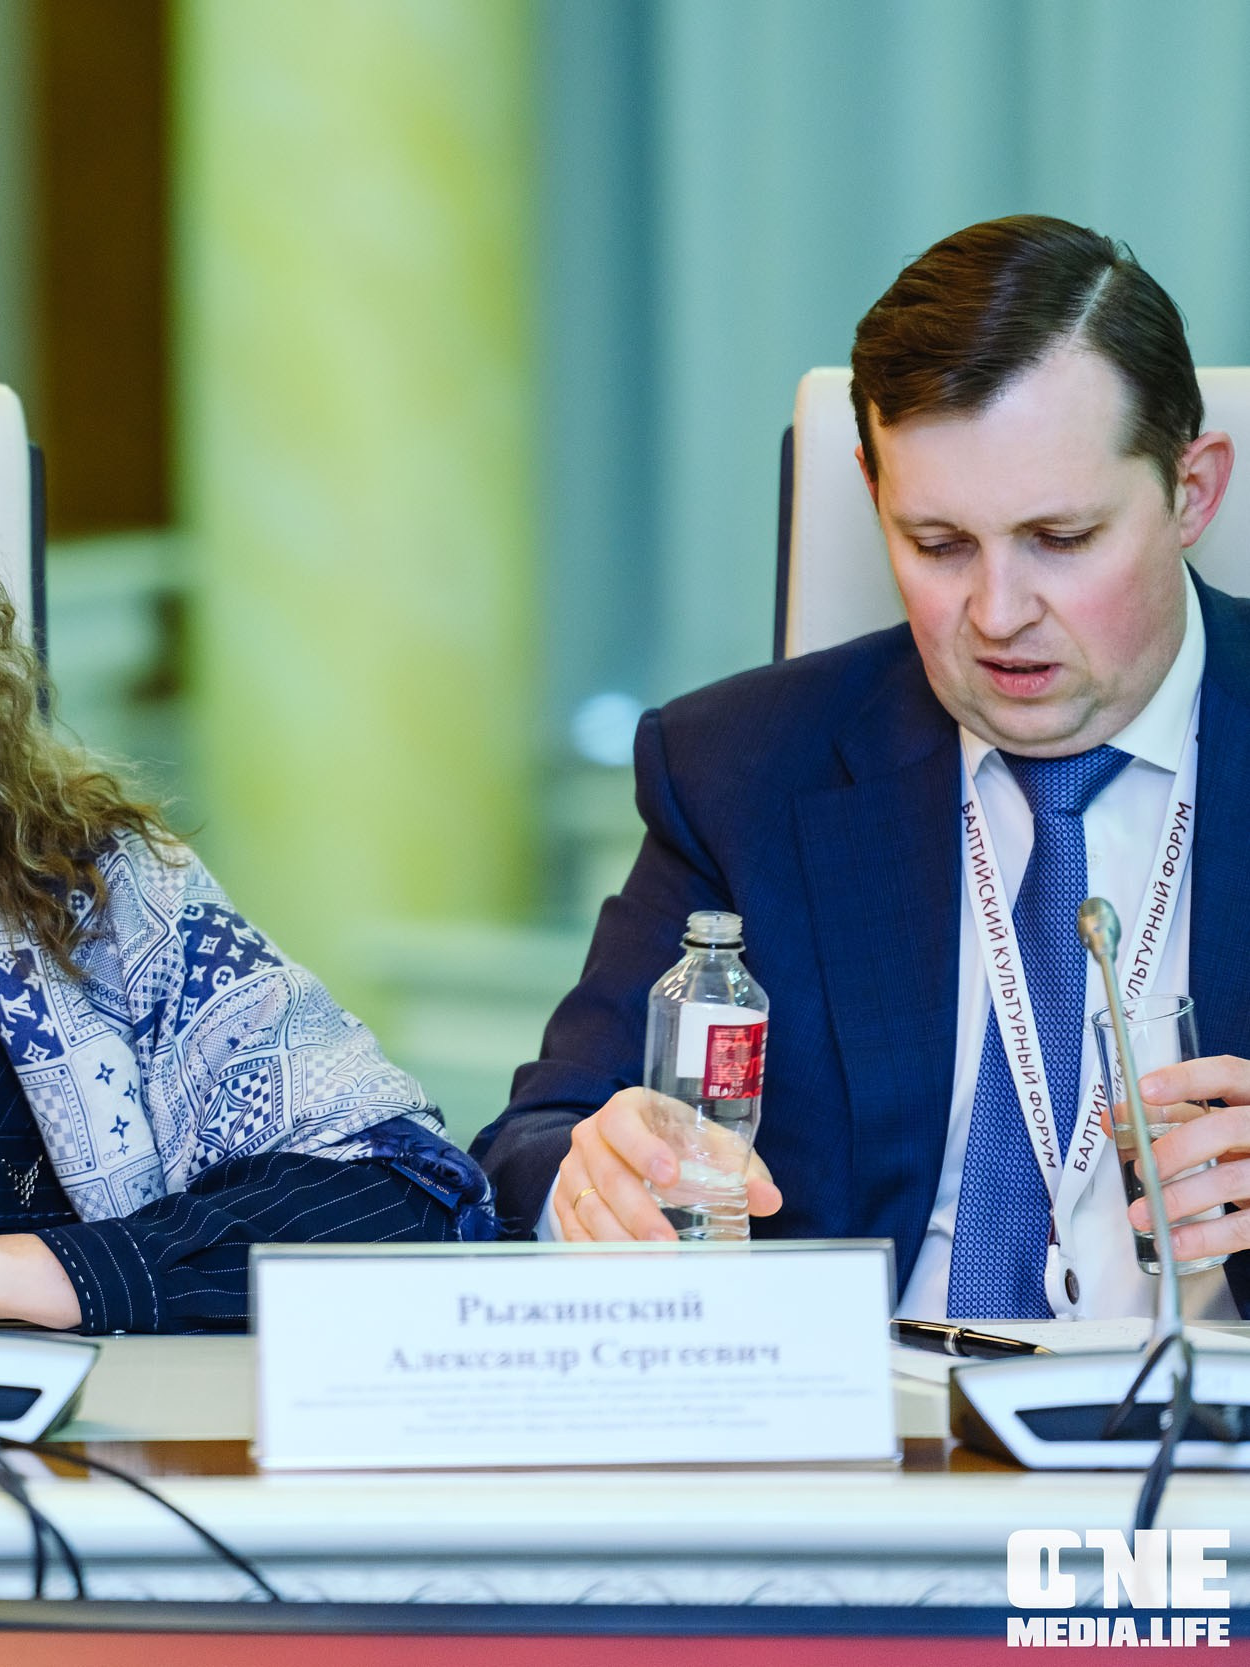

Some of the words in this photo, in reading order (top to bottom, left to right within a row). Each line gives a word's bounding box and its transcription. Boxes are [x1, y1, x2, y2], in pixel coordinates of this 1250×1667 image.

[1161, 800, 1193, 878] ФОРУМ
[961, 800, 1008, 942] БАЛТИЙСКИЙ
[992, 946, 1042, 1085] КУЛЬТУРНЫЙ
[1028, 1090, 1057, 1169] ФОРУМ
[457, 1291, 704, 1327] Рыжинский
[387, 1346, 581, 1377] Александр
[590, 1341, 782, 1376] Сергеевич
